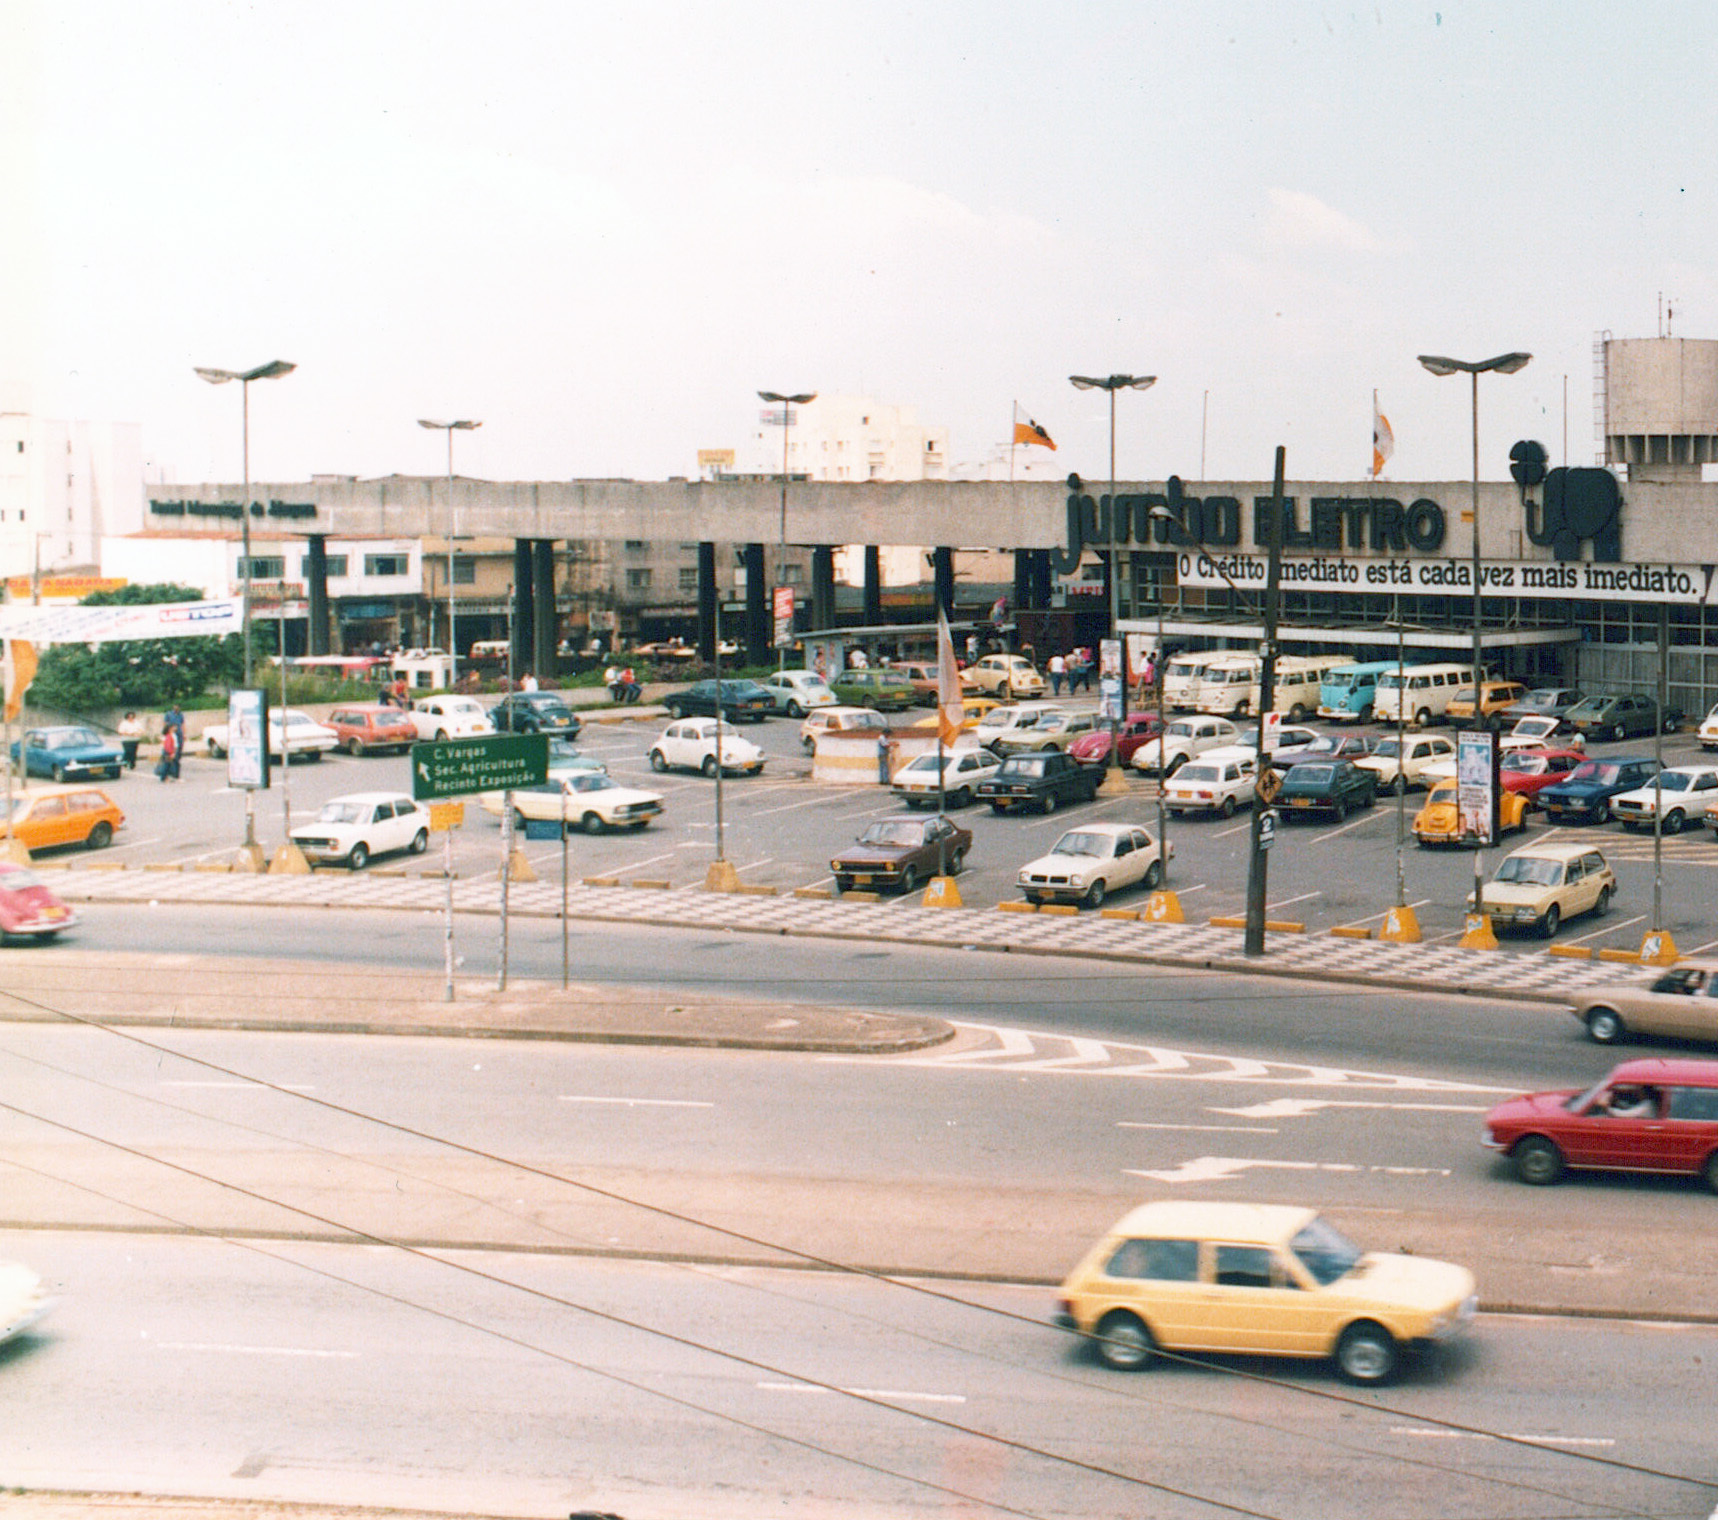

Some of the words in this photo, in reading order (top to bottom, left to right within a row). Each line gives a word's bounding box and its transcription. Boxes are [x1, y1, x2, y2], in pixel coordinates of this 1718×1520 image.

[1050, 473, 1241, 575] jumbo
[1254, 496, 1446, 551] ELETRO
[1180, 554, 1191, 577] O
[1197, 553, 1266, 581] Crédito
[1278, 558, 1359, 583] mediato
[1366, 560, 1413, 584] está
[1419, 559, 1471, 586] cada
[1478, 566, 1514, 587] vez
[1521, 562, 1578, 589] mais
[1584, 565, 1698, 594] imediato.
[448, 746, 487, 760] Vargas
[434, 764, 458, 777] Sec.
[460, 757, 526, 775] Agricultura
[434, 776, 477, 791] Recinto
[479, 770, 536, 788] Exposição
